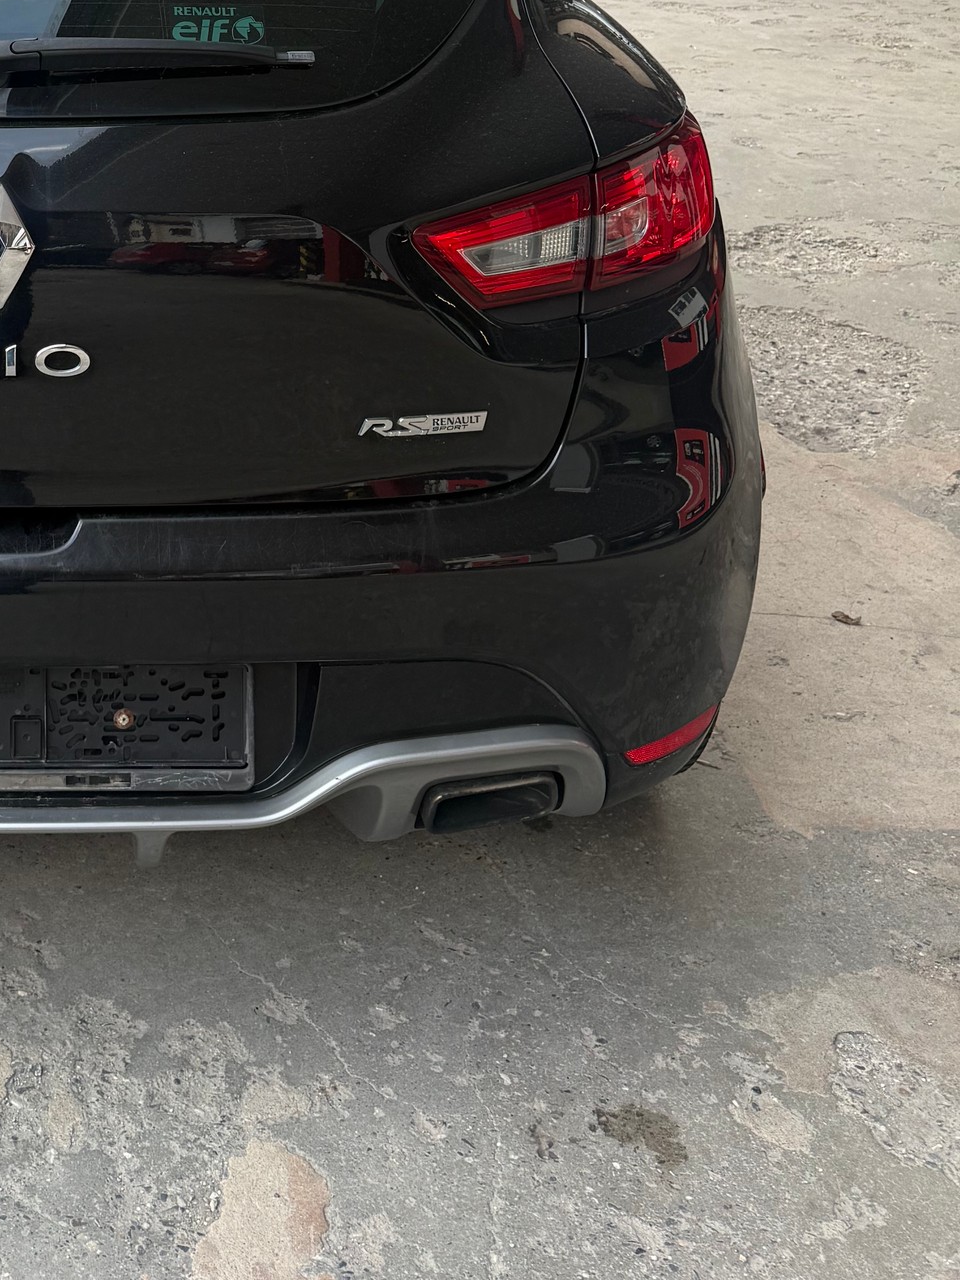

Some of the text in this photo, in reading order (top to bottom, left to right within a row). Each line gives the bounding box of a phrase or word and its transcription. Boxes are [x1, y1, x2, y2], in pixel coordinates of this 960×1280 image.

[173, 6, 236, 17] RENAULT
[172, 19, 229, 42] elf
[432, 415, 481, 426] RENAULT
[432, 424, 469, 432] SPORT
